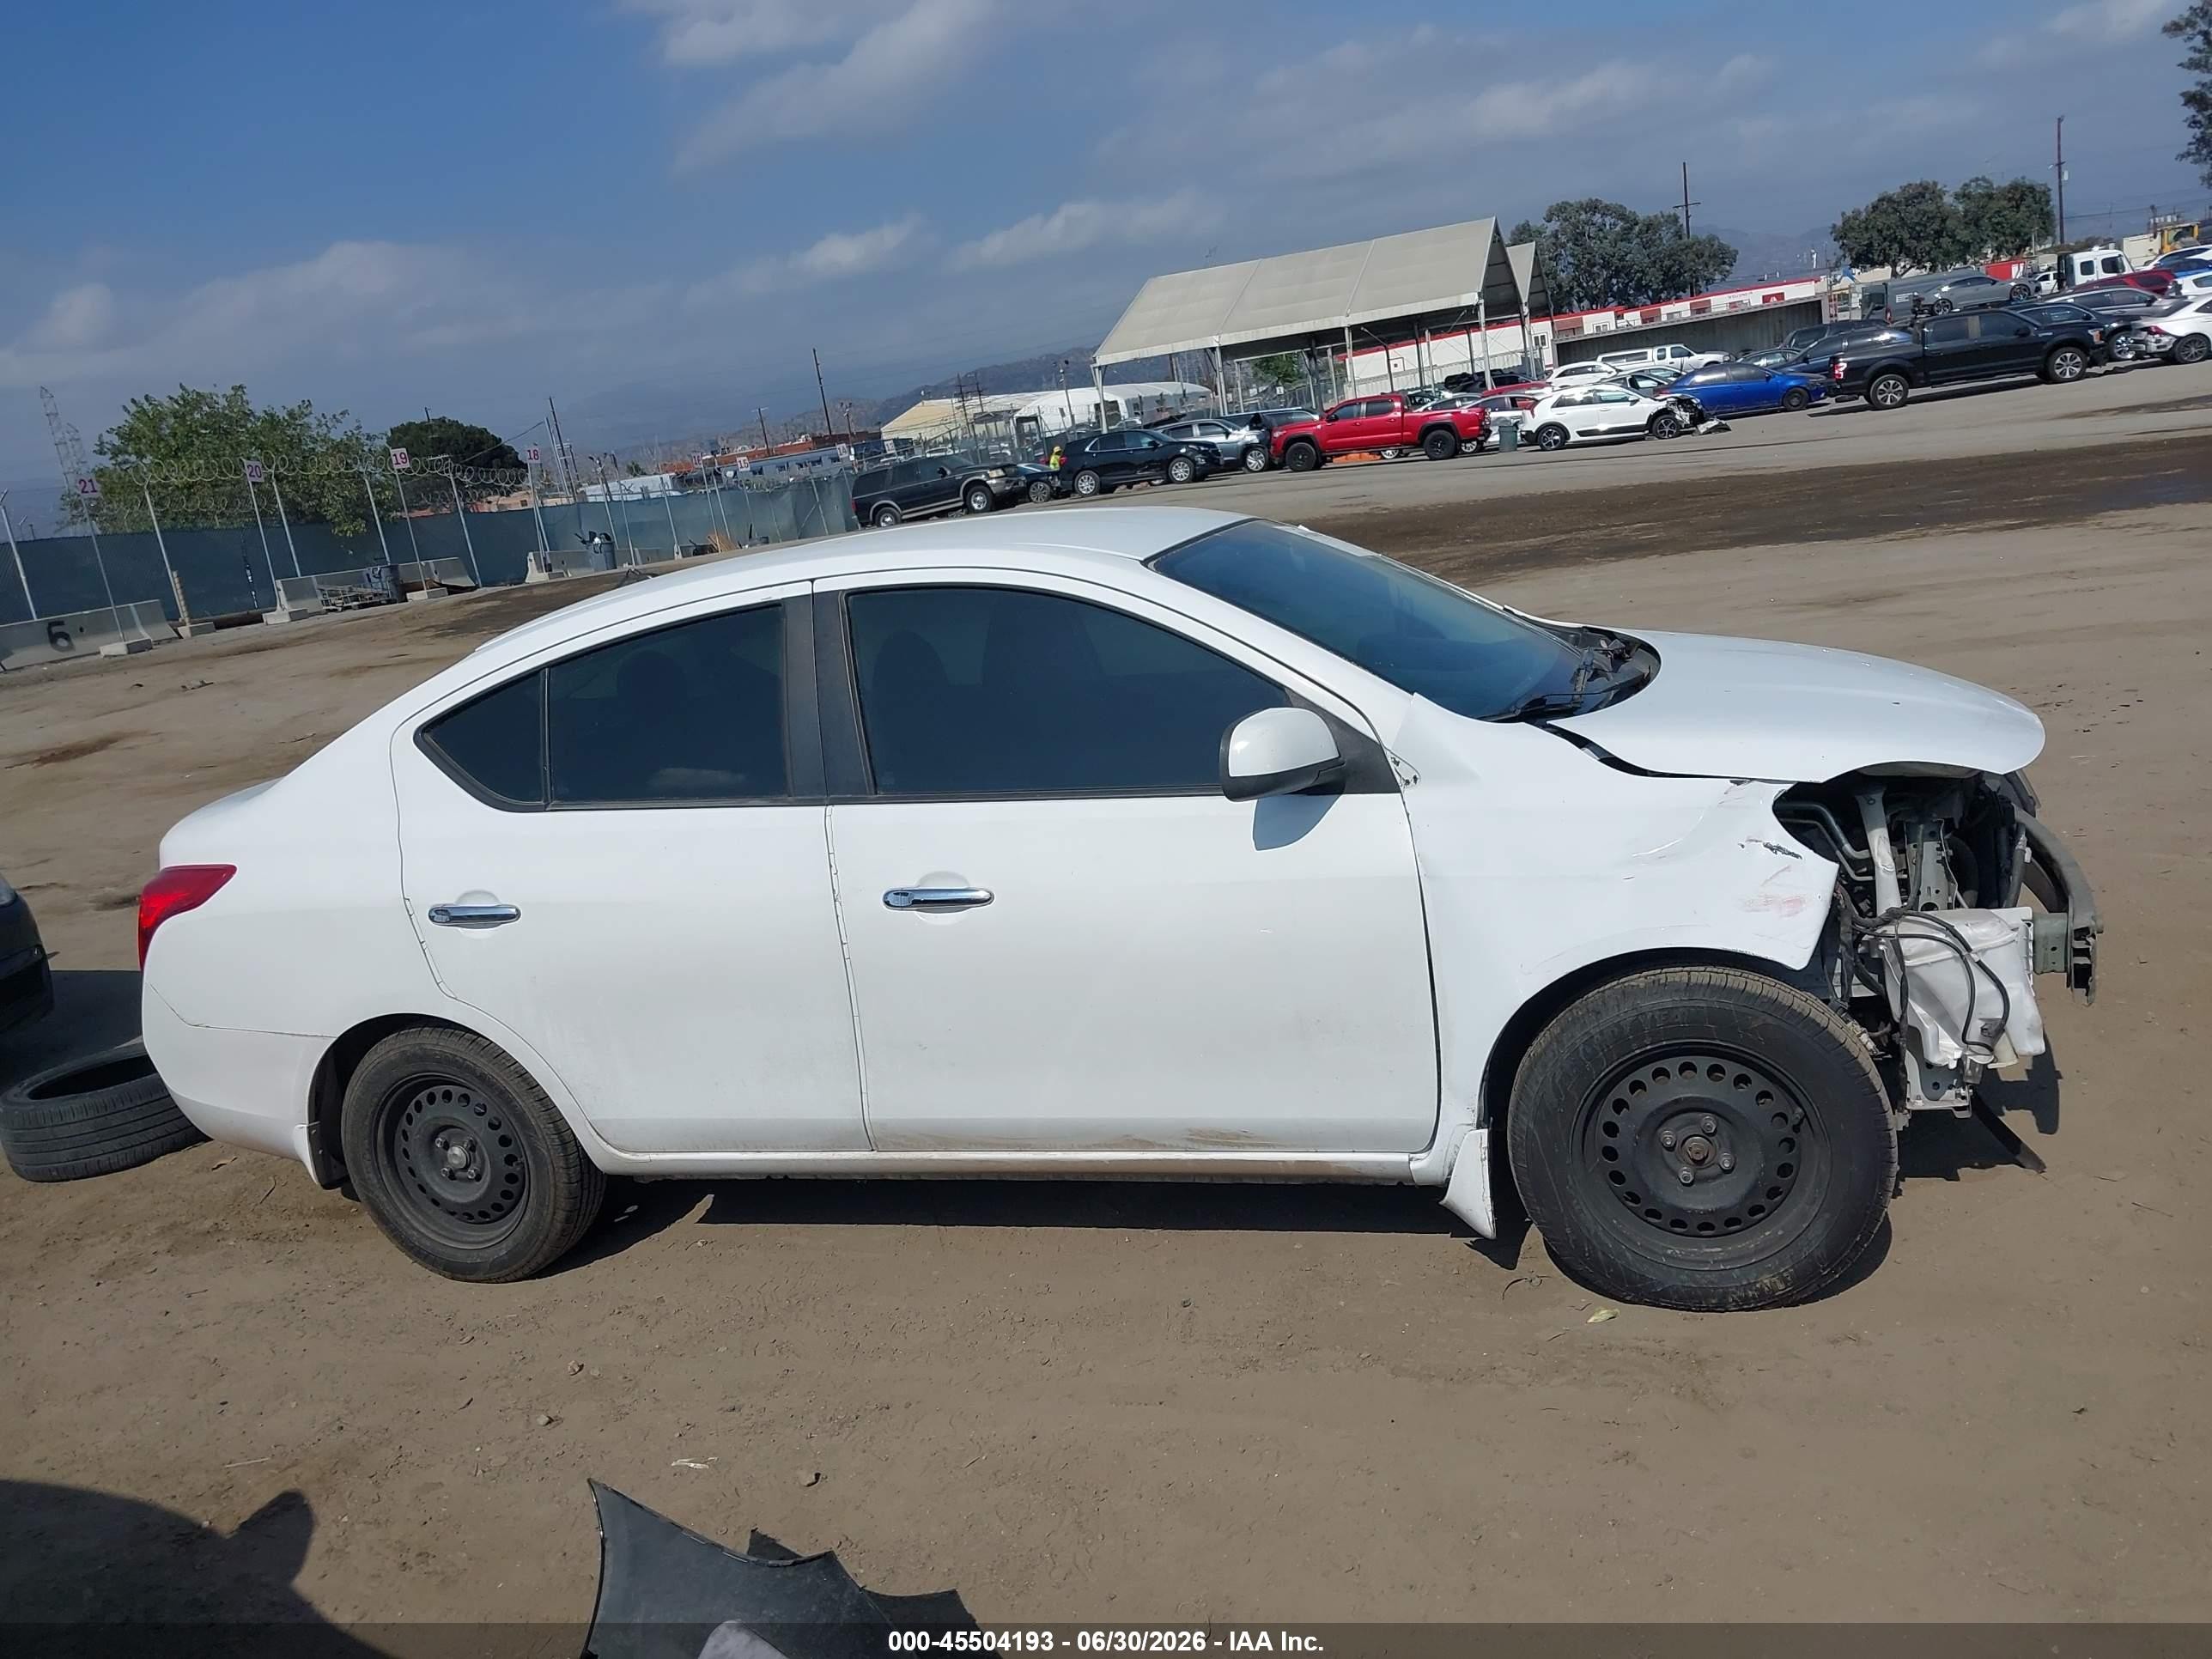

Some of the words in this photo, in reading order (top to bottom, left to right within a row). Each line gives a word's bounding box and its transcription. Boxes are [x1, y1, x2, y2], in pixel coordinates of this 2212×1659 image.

[392, 452, 408, 466] 19
[527, 449, 540, 461] 18
[246, 464, 263, 479] 20
[78, 477, 98, 494] 21
[46, 621, 76, 653] 6
